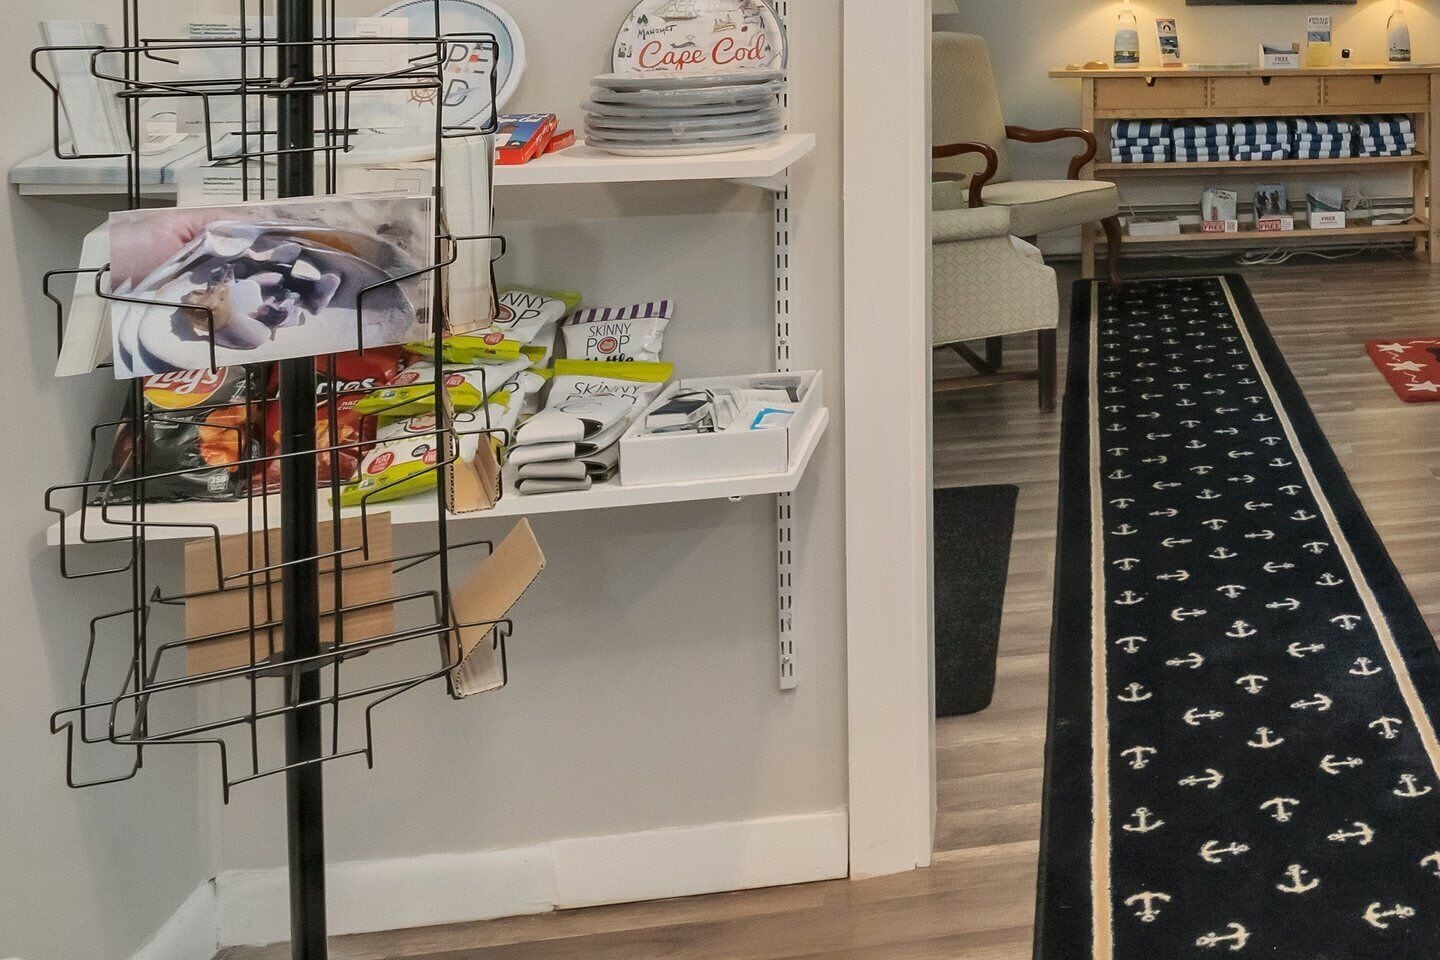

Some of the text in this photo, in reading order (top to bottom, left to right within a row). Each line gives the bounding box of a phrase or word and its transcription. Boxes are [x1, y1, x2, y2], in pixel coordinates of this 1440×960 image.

[638, 33, 766, 71] Cape Cod
[588, 322, 632, 338] SKINNY
[586, 335, 631, 356] POP
